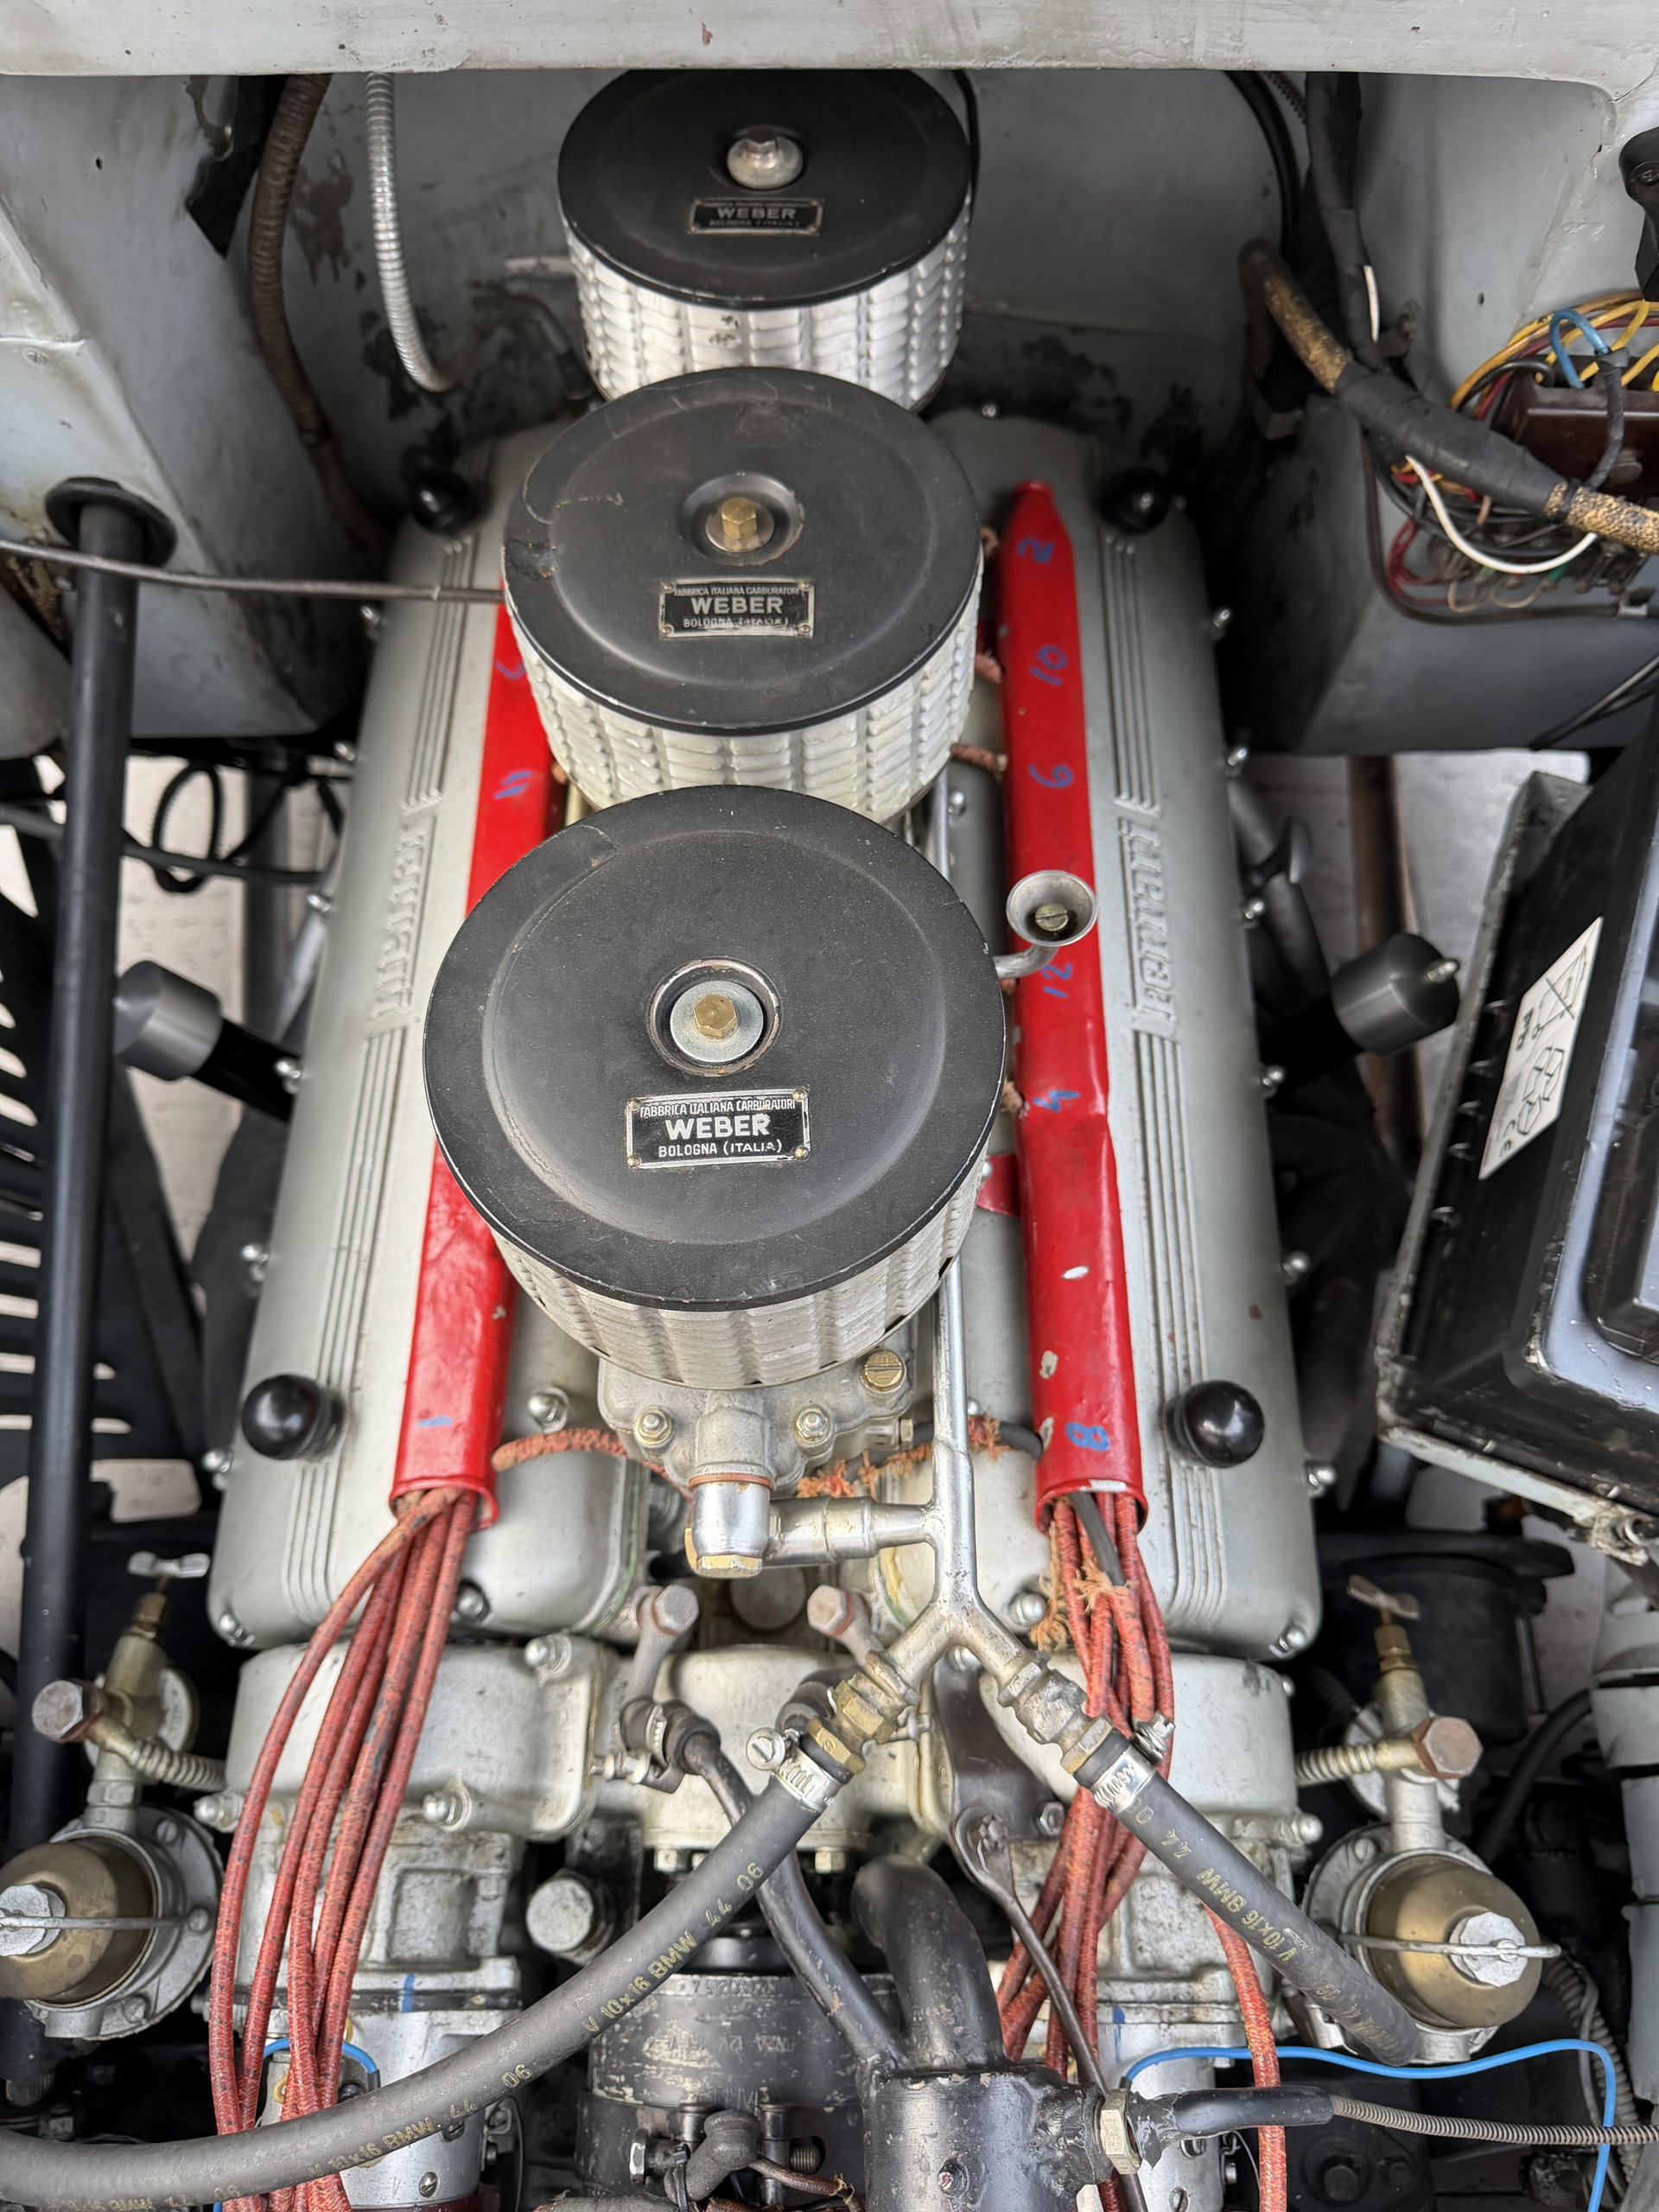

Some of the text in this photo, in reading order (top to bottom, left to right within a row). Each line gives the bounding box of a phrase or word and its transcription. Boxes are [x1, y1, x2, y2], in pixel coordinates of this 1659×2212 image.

[717, 207, 797, 219] WEBER
[691, 596, 784, 614] WEBER
[711, 587, 745, 595] ITALIANA
[1029, 645, 1067, 685] 10
[1118, 817, 1177, 1024] Ferrari
[639, 1099, 796, 1118] FABBRICA ITALIANA CARBURATORI
[664, 1114, 771, 1141] WEBER
[658, 1139, 782, 1158] BOLOGNA (ITALIA)
[1065, 1421, 1110, 1452] 8
[1196, 1866, 1247, 1914] BMW
[1241, 1910, 1286, 1949] 10x16
[582, 2016, 600, 2031] V
[601, 1976, 652, 2019] 10x16
[648, 1930, 697, 1979] BMW
[737, 1862, 764, 1891] 06
[382, 2117, 435, 2149] BMW
[501, 2063, 533, 2088] 06
